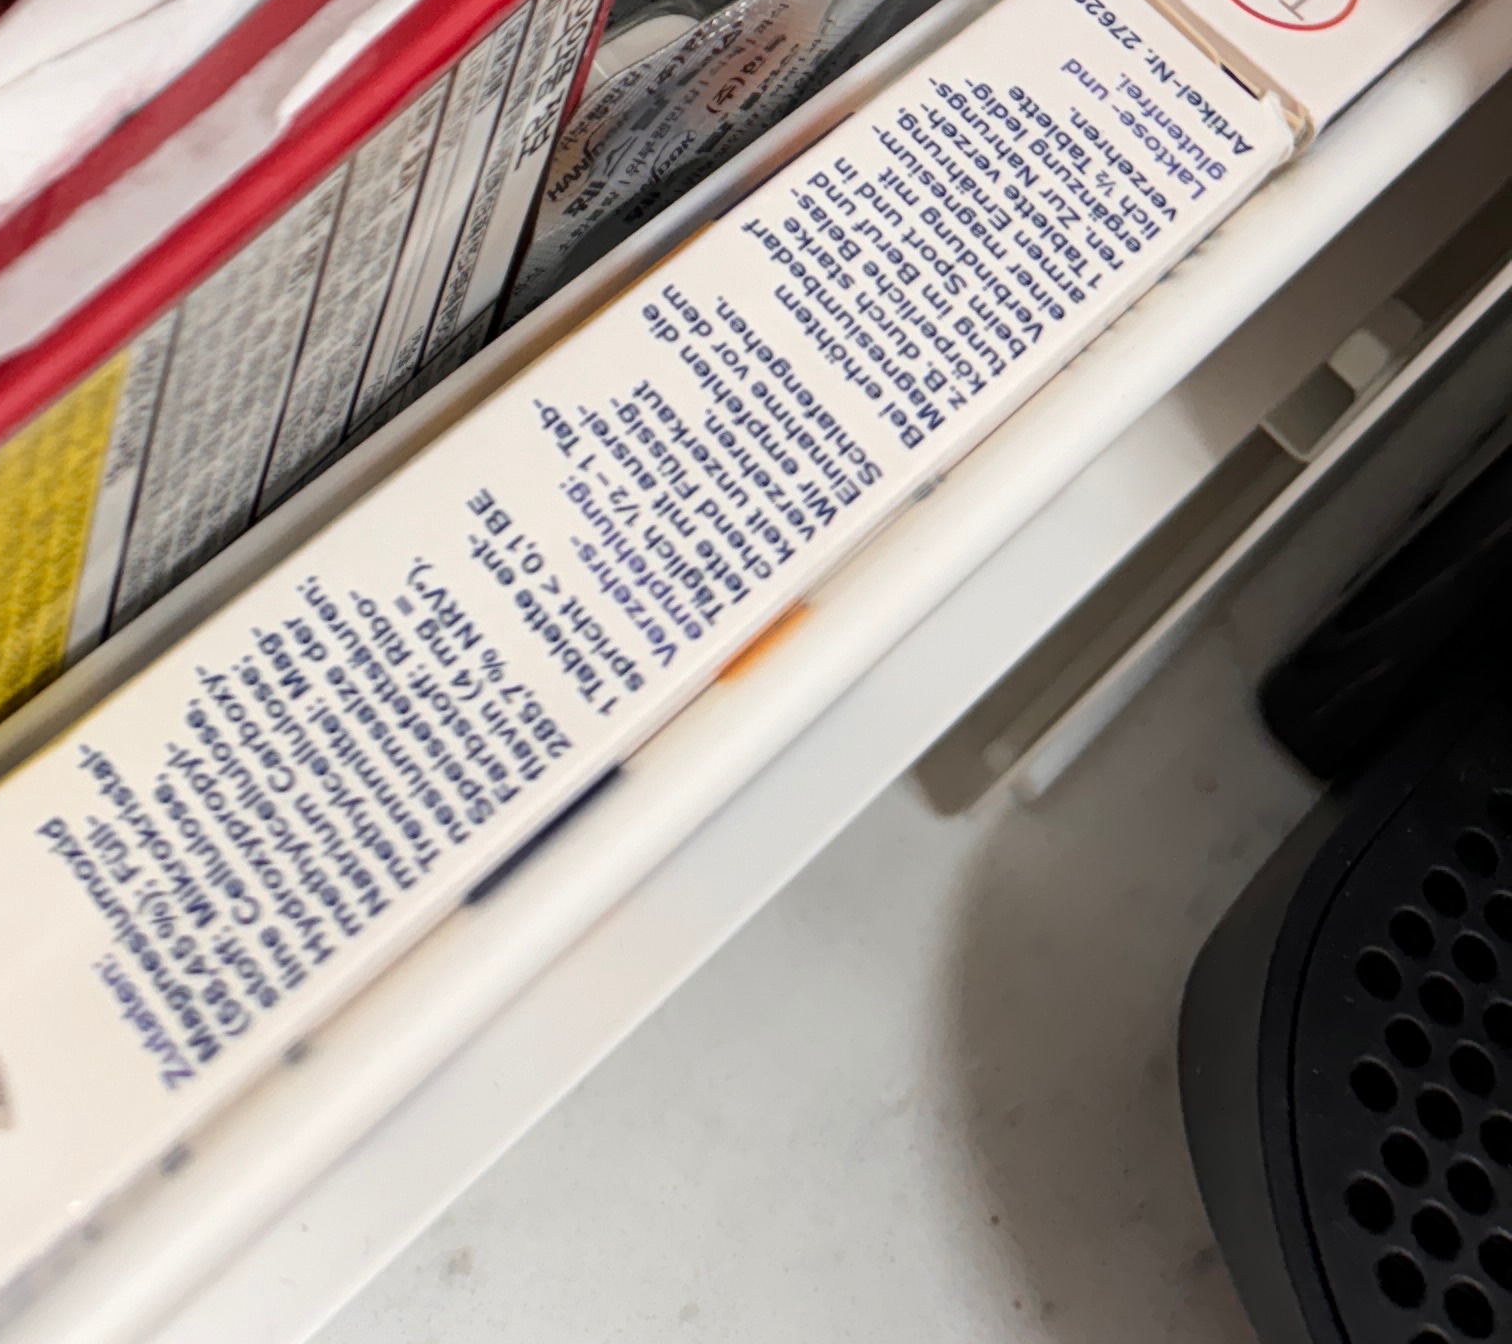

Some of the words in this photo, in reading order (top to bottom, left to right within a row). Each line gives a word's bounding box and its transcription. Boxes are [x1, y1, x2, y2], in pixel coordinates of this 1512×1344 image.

[966, 81, 1027, 141] ledig-
[1061, 59, 1108, 100] und
[1146, 50, 1252, 154] Artikel-Nr.
[922, 105, 1000, 183] verzeh-
[930, 79, 1038, 187] Nahrungs-
[1009, 87, 1090, 173] Tablette
[1071, 108, 1176, 220] verzehren.
[1113, 106, 1205, 199] Laktose-
[1117, 74, 1226, 180] glutenfrei.
[807, 172, 856, 216] und
[834, 158, 858, 183] in
[854, 182, 903, 227] und
[874, 127, 1006, 258] magnesium-
[878, 168, 919, 206] mit
[898, 109, 1011, 231] Ernährung,
[1029, 139, 1141, 252] ergänzung
[1039, 189, 1081, 229] Zur
[784, 218, 854, 289] starke
[792, 190, 861, 261] Belas-
[852, 220, 920, 285] Beruf
[1004, 185, 1087, 277] Tablette
[1086, 227, 1123, 270] ren.
[1119, 196, 1160, 240] lich
[902, 228, 967, 295] Sport
[921, 208, 1042, 342] Verbindung
[1007, 264, 1065, 320] einer
[1014, 231, 1085, 303] armen
[1087, 274, 1102, 288] 1
[643, 305, 679, 342] die
[663, 285, 712, 337] dem
[744, 221, 944, 429] Magnesiumbedarf
[856, 292, 920, 359] durch
[863, 262, 986, 394] körperliche
[922, 284, 953, 319] im
[969, 295, 1027, 359] beim
[712, 343, 749, 380] vor
[776, 286, 882, 399] erhöhtem
[954, 317, 1006, 376] tung
[681, 346, 798, 475] empfehlen
[718, 298, 881, 485] Schlafengehen.
[924, 362, 967, 409] z.B.
[535, 400, 579, 456] Tab-
[578, 455, 595, 471] 1
[580, 407, 656, 490] ausrei-
[613, 400, 699, 499] Flüssig-
[634, 382, 748, 507] unzerkaut
[752, 382, 860, 504] Einnahme
[880, 403, 924, 449] Bei
[468, 490, 511, 535] BE
[706, 411, 815, 540] verzehren.
[799, 482, 837, 526] Wir
[653, 493, 696, 537] mit
[695, 499, 772, 579] chend
[746, 510, 795, 564] keit
[470, 536, 515, 585] ent-
[506, 535, 544, 574] 0,1
[562, 478, 702, 639] empfehlung:
[644, 526, 723, 624] Täglich
[697, 541, 750, 603] lette
[278, 618, 327, 662] der
[352, 592, 411, 666] Ribo-
[573, 539, 676, 666] Verzehrs-
[254, 630, 310, 699] Mag-
[516, 591, 602, 701] Tablette
[560, 598, 643, 691] spricht
[197, 669, 295, 793] Carboxy-
[410, 666, 519, 803] Farbstoff:
[599, 697, 617, 714] 1
[234, 657, 415, 888] methylcellulose;
[309, 700, 438, 871] Trennmittel:
[327, 668, 468, 843] nesiumsalze
[82, 747, 216, 927] Mikrokristal-
[156, 775, 260, 925] Cellulose,
[169, 746, 333, 963] Hydroxypropyl-
[188, 701, 361, 935] methylcellulose,
[295, 795, 389, 916] Natrium
[41, 820, 221, 1061] Magnesiumoxid
[215, 929, 279, 1008] stoff:
[261, 927, 307, 989] line
